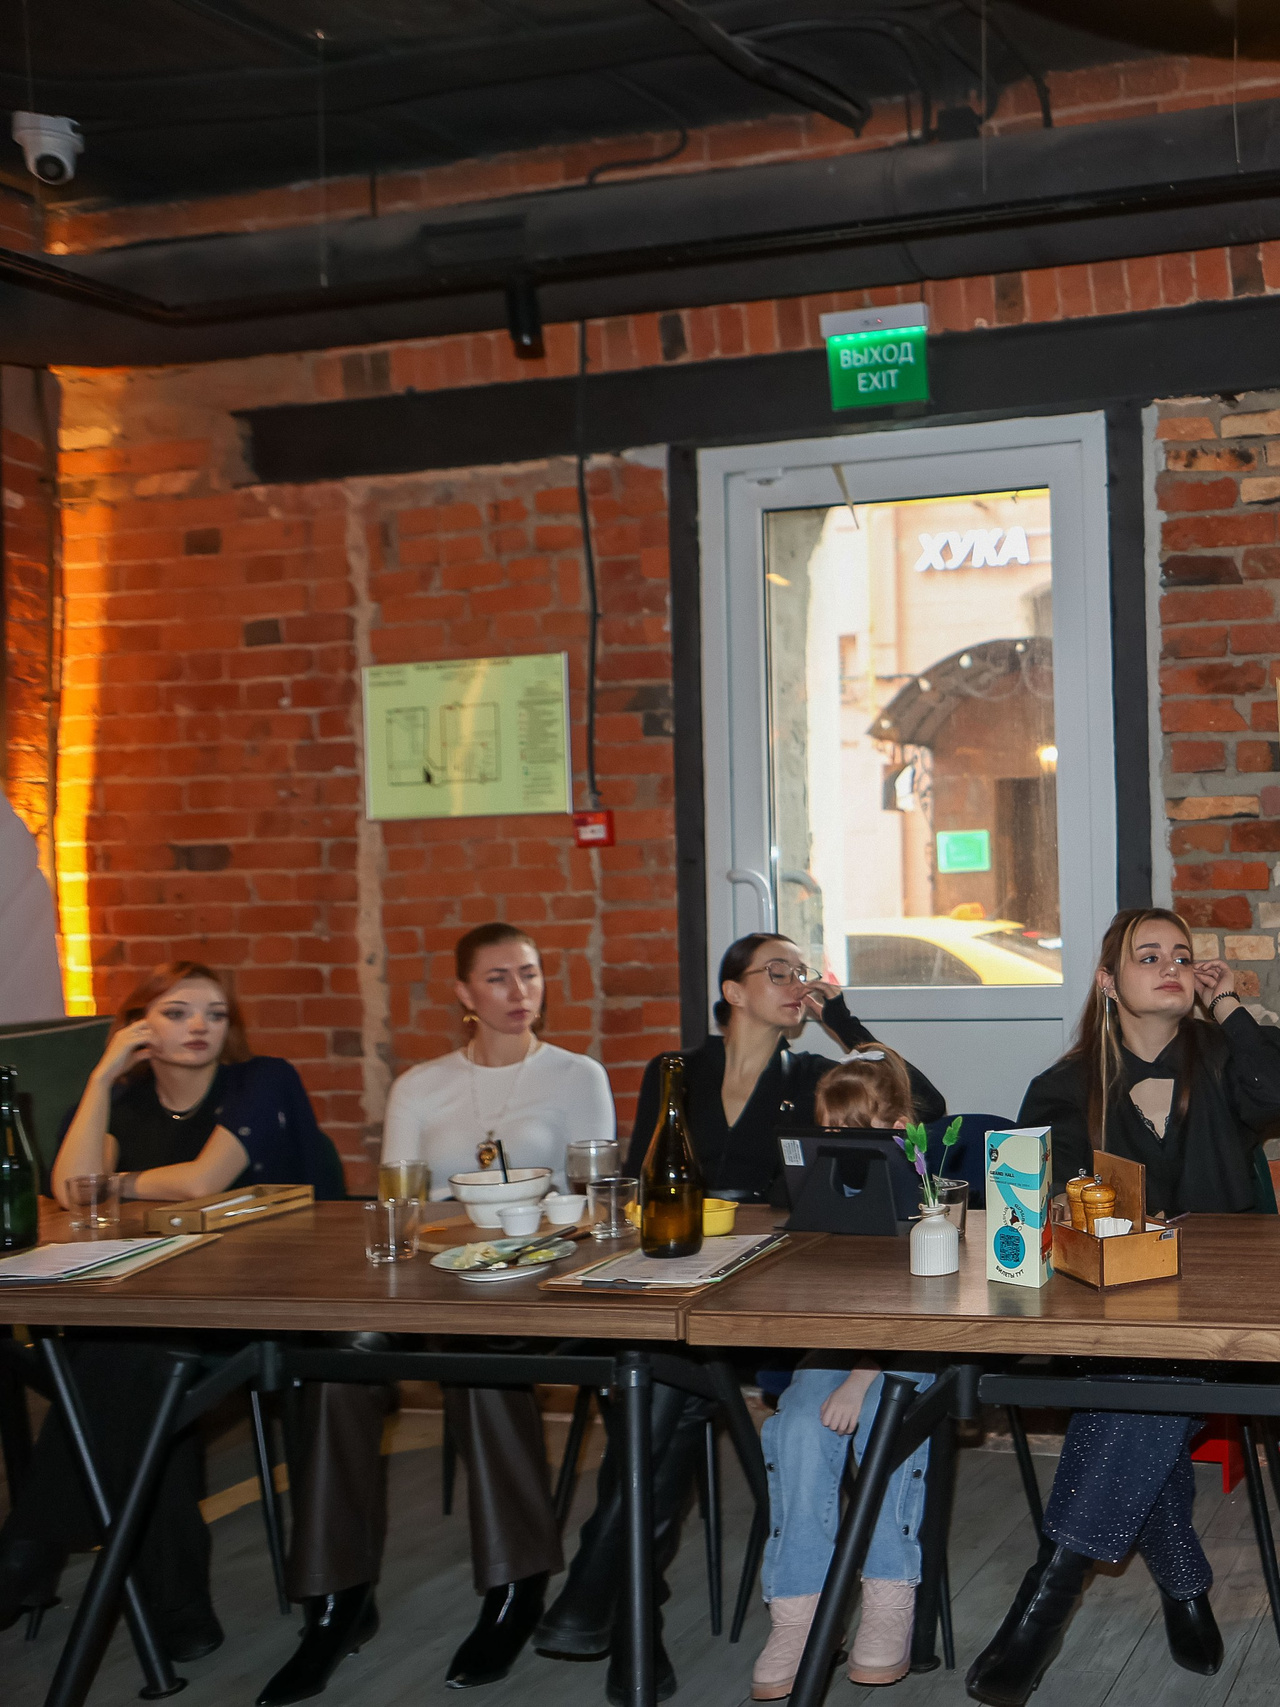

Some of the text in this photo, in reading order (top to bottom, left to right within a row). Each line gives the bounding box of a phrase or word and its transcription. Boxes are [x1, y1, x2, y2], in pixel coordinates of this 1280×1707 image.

[840, 341, 914, 369] ВЫХОД
[857, 369, 900, 392] EXIT
[914, 526, 1030, 572] ХУКА
